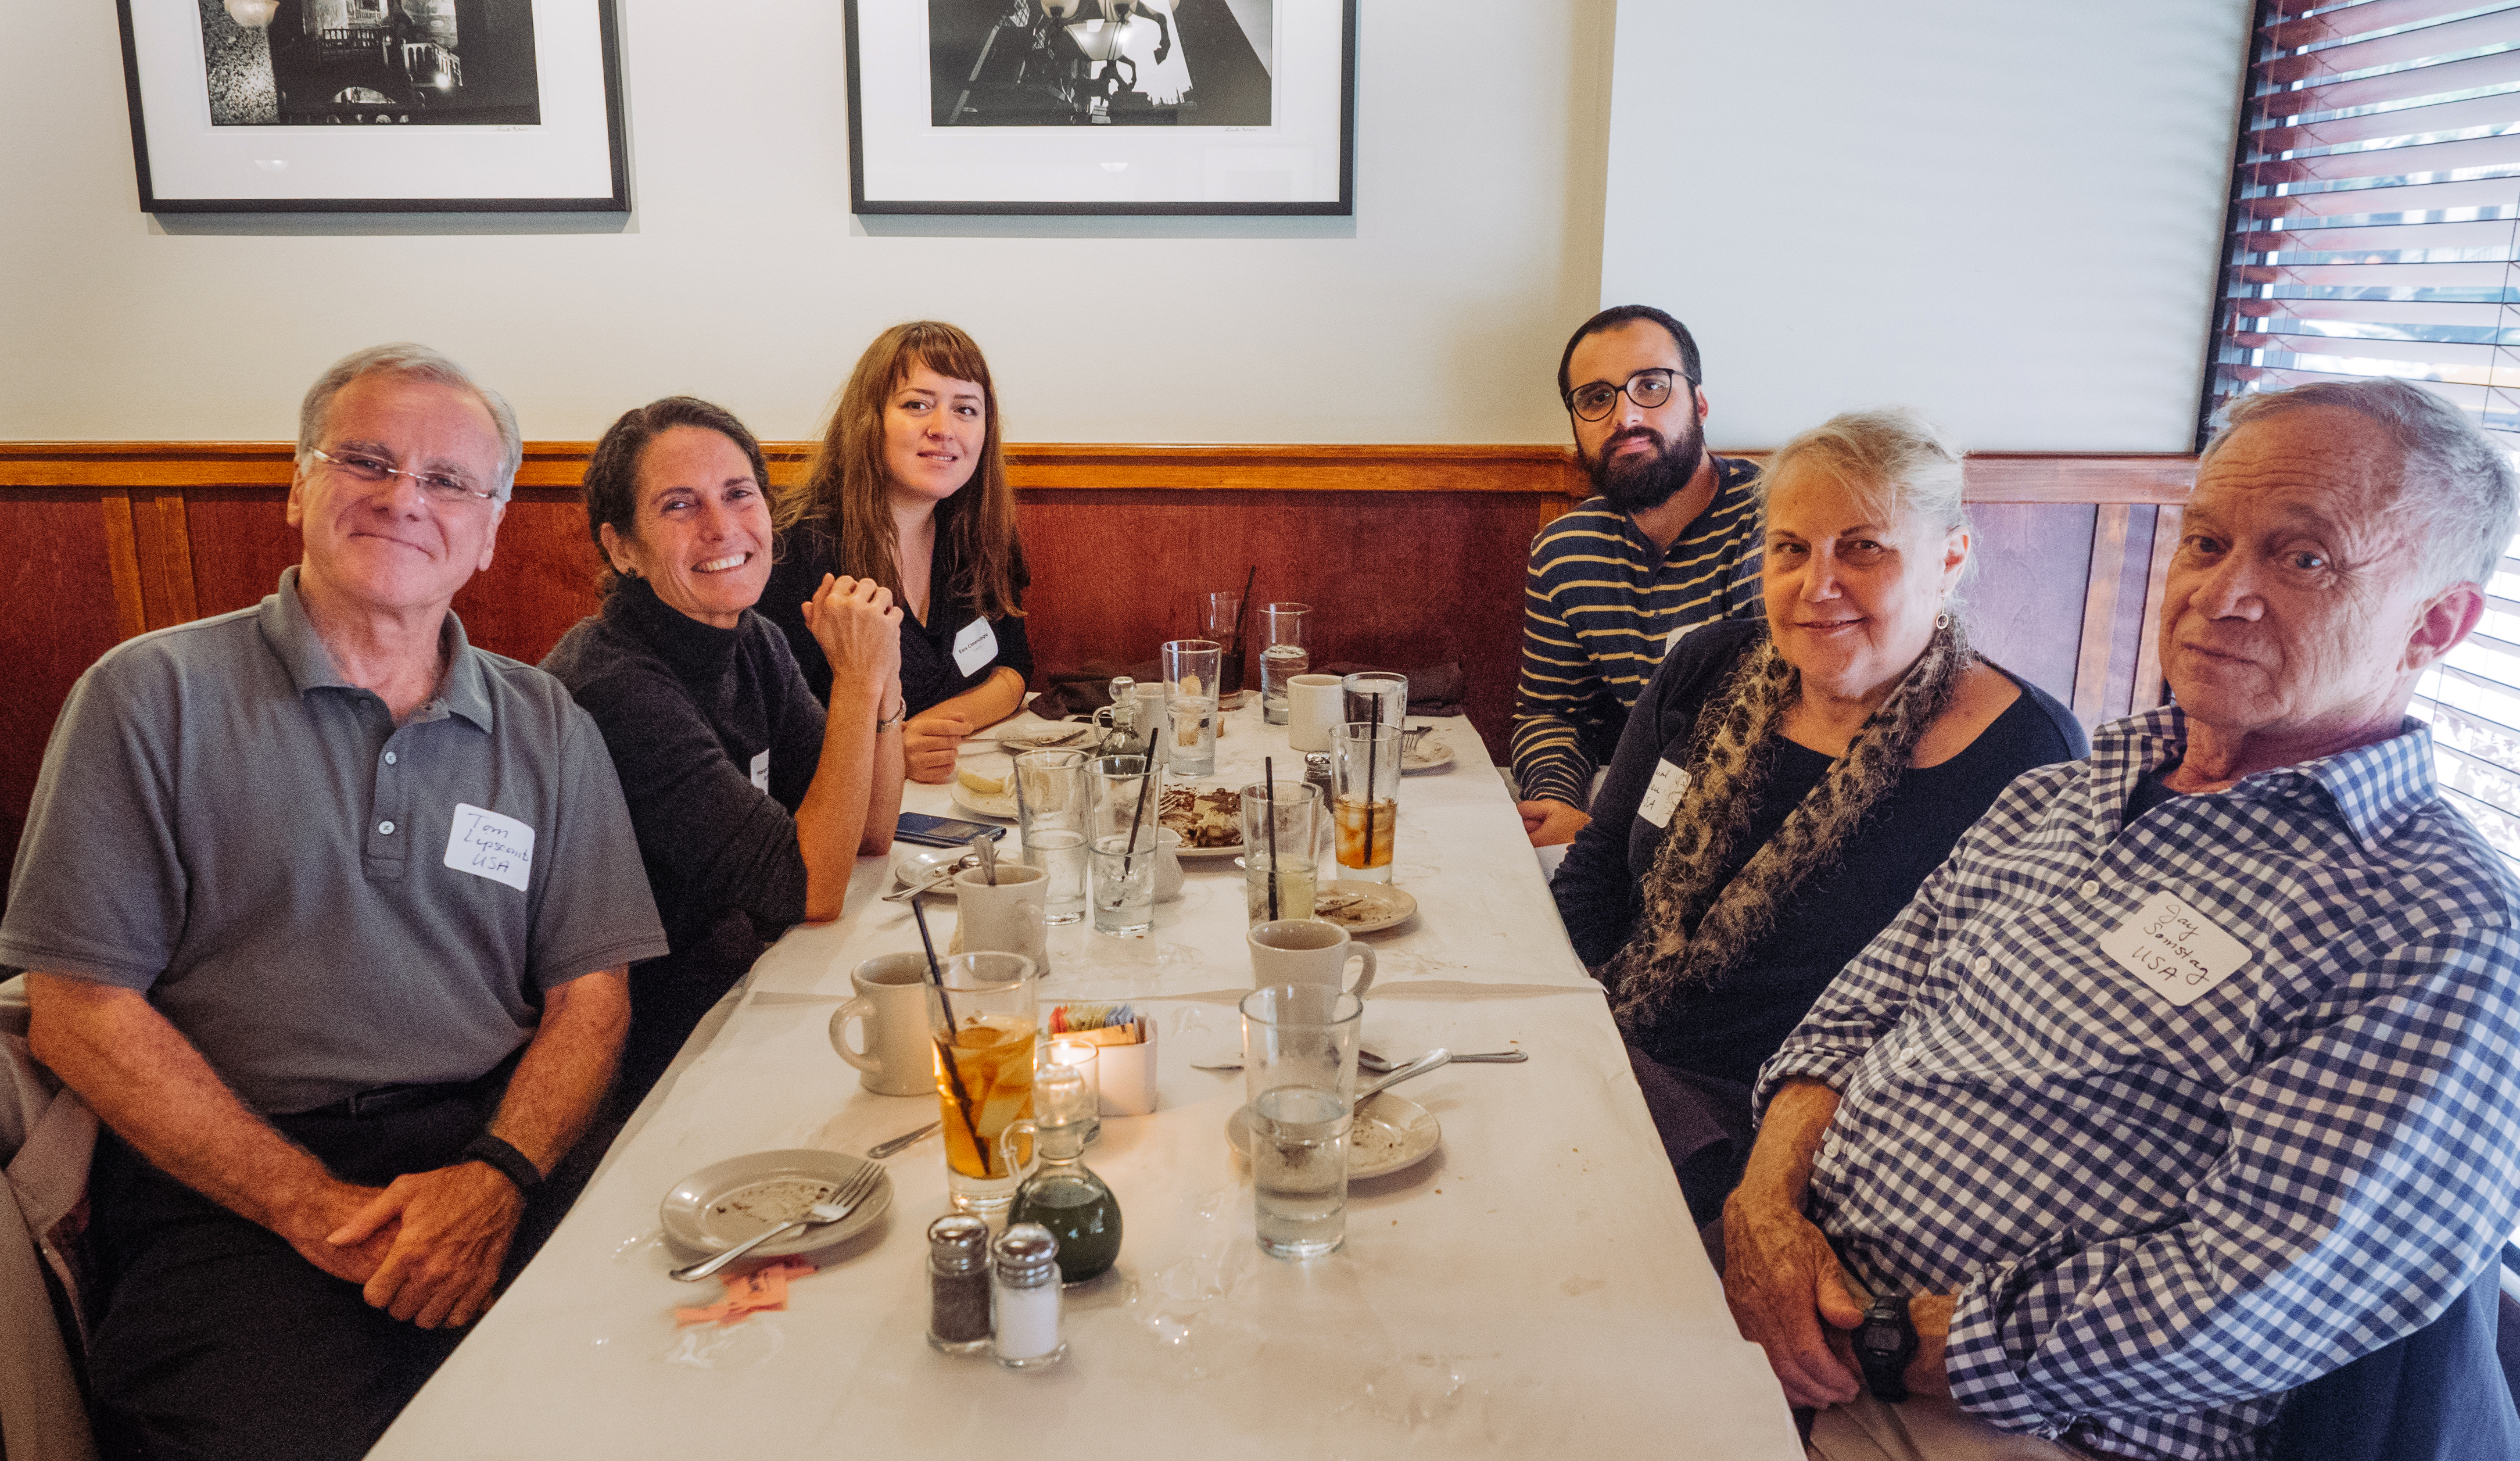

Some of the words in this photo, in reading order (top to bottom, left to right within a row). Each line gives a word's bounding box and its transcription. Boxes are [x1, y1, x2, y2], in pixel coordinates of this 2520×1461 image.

[1643, 797, 1656, 810] SA
[468, 813, 509, 838] Tom
[472, 853, 510, 872] USA
[2158, 904, 2200, 941] Jay
[2132, 946, 2177, 980] USA
